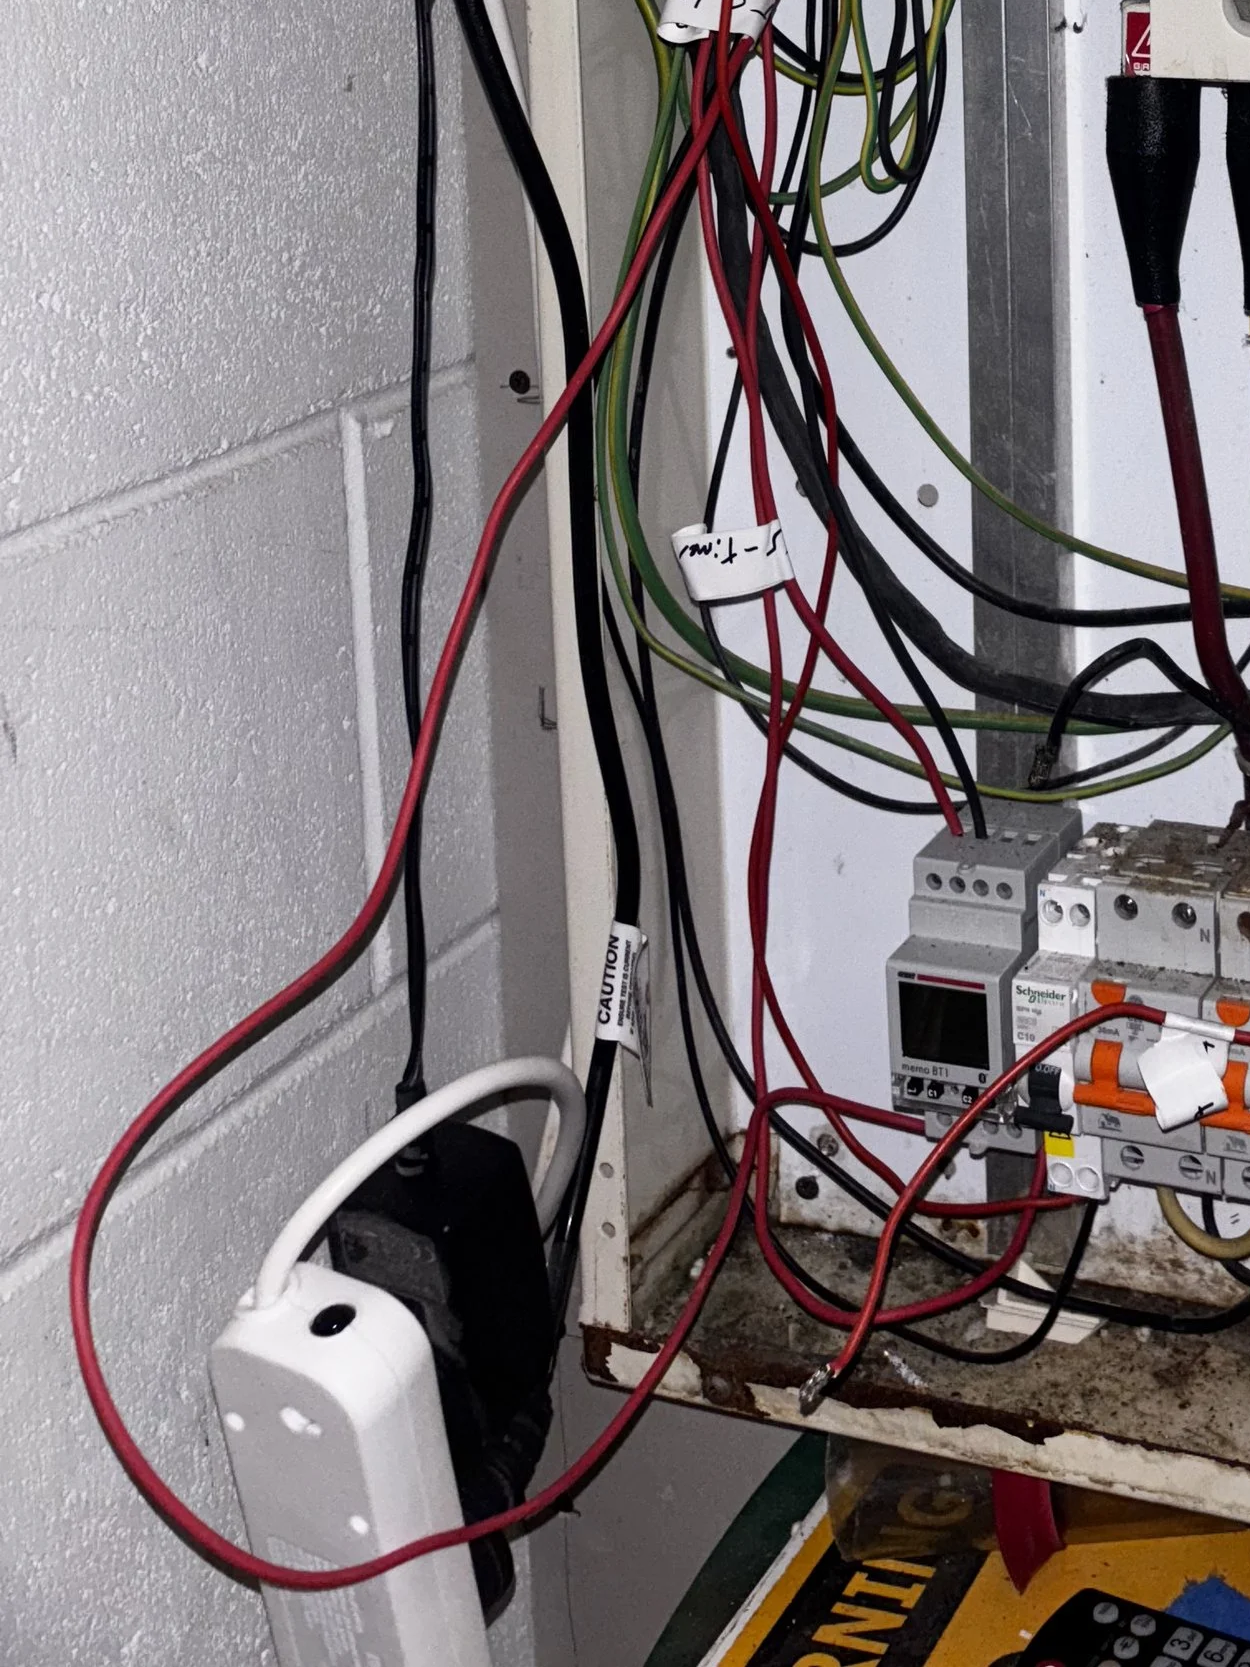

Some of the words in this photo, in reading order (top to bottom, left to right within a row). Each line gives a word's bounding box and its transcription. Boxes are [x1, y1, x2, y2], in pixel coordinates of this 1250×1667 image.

[1199, 929, 1211, 944] N
[597, 935, 620, 1025] CAUTION
[1015, 985, 1067, 1002] Schneider
[1205, 1171, 1217, 1187] N
[1169, 1639, 1192, 1653] 3
[1203, 1649, 1225, 1664] 6
